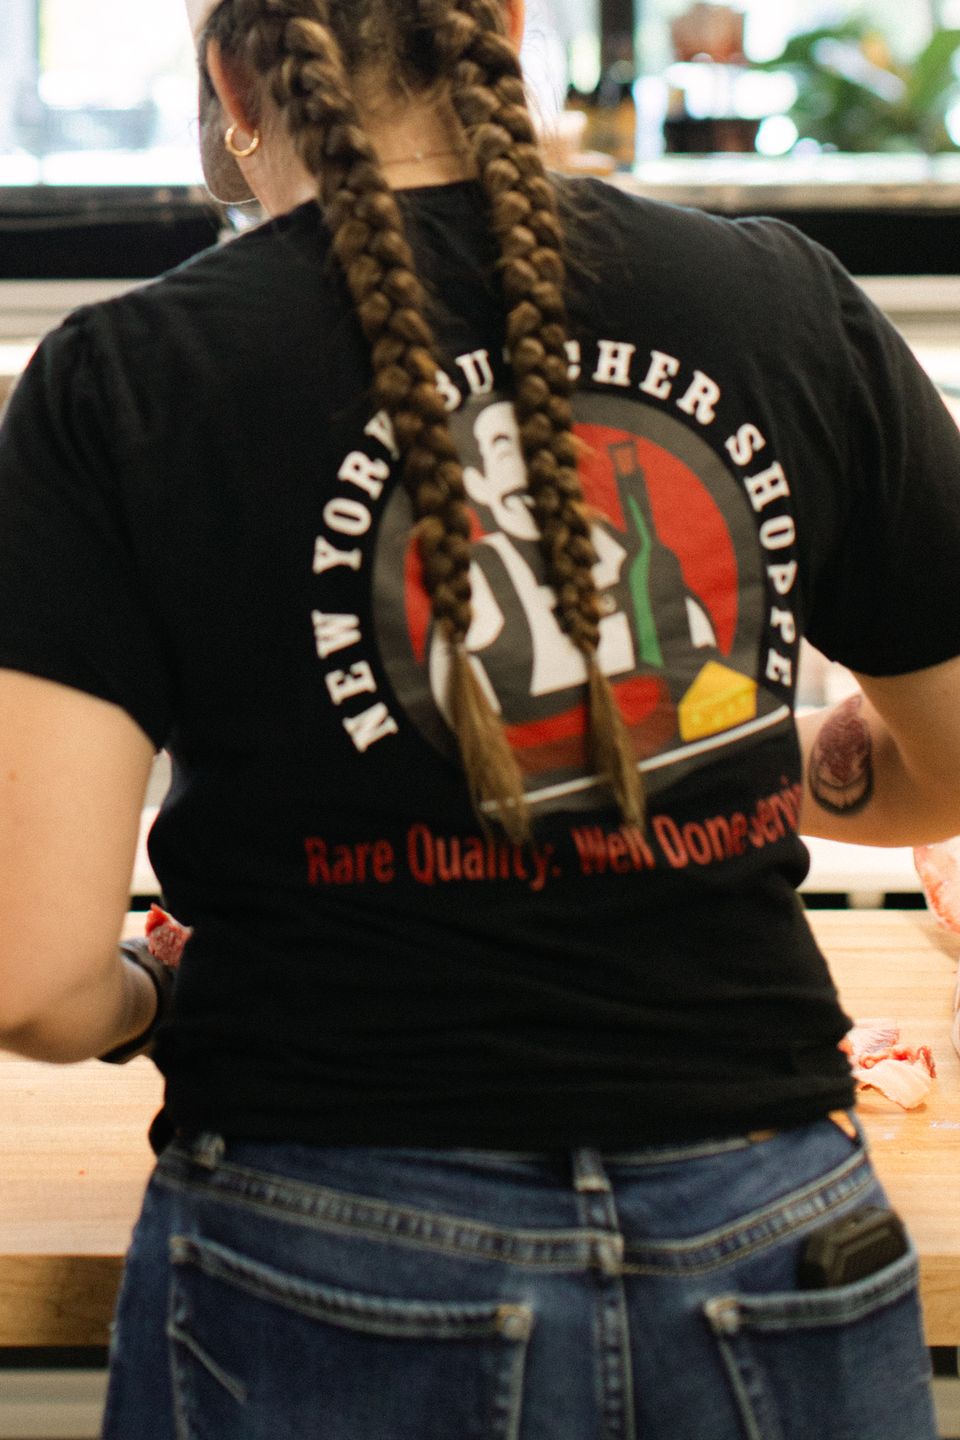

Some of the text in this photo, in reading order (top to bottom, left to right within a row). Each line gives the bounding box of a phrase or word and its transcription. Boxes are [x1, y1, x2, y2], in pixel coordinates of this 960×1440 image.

[311, 609, 400, 753] NEW
[724, 422, 798, 688] SHOPPE
[303, 835, 395, 886] Rare
[570, 824, 656, 875] Well
[652, 813, 749, 870] Done
